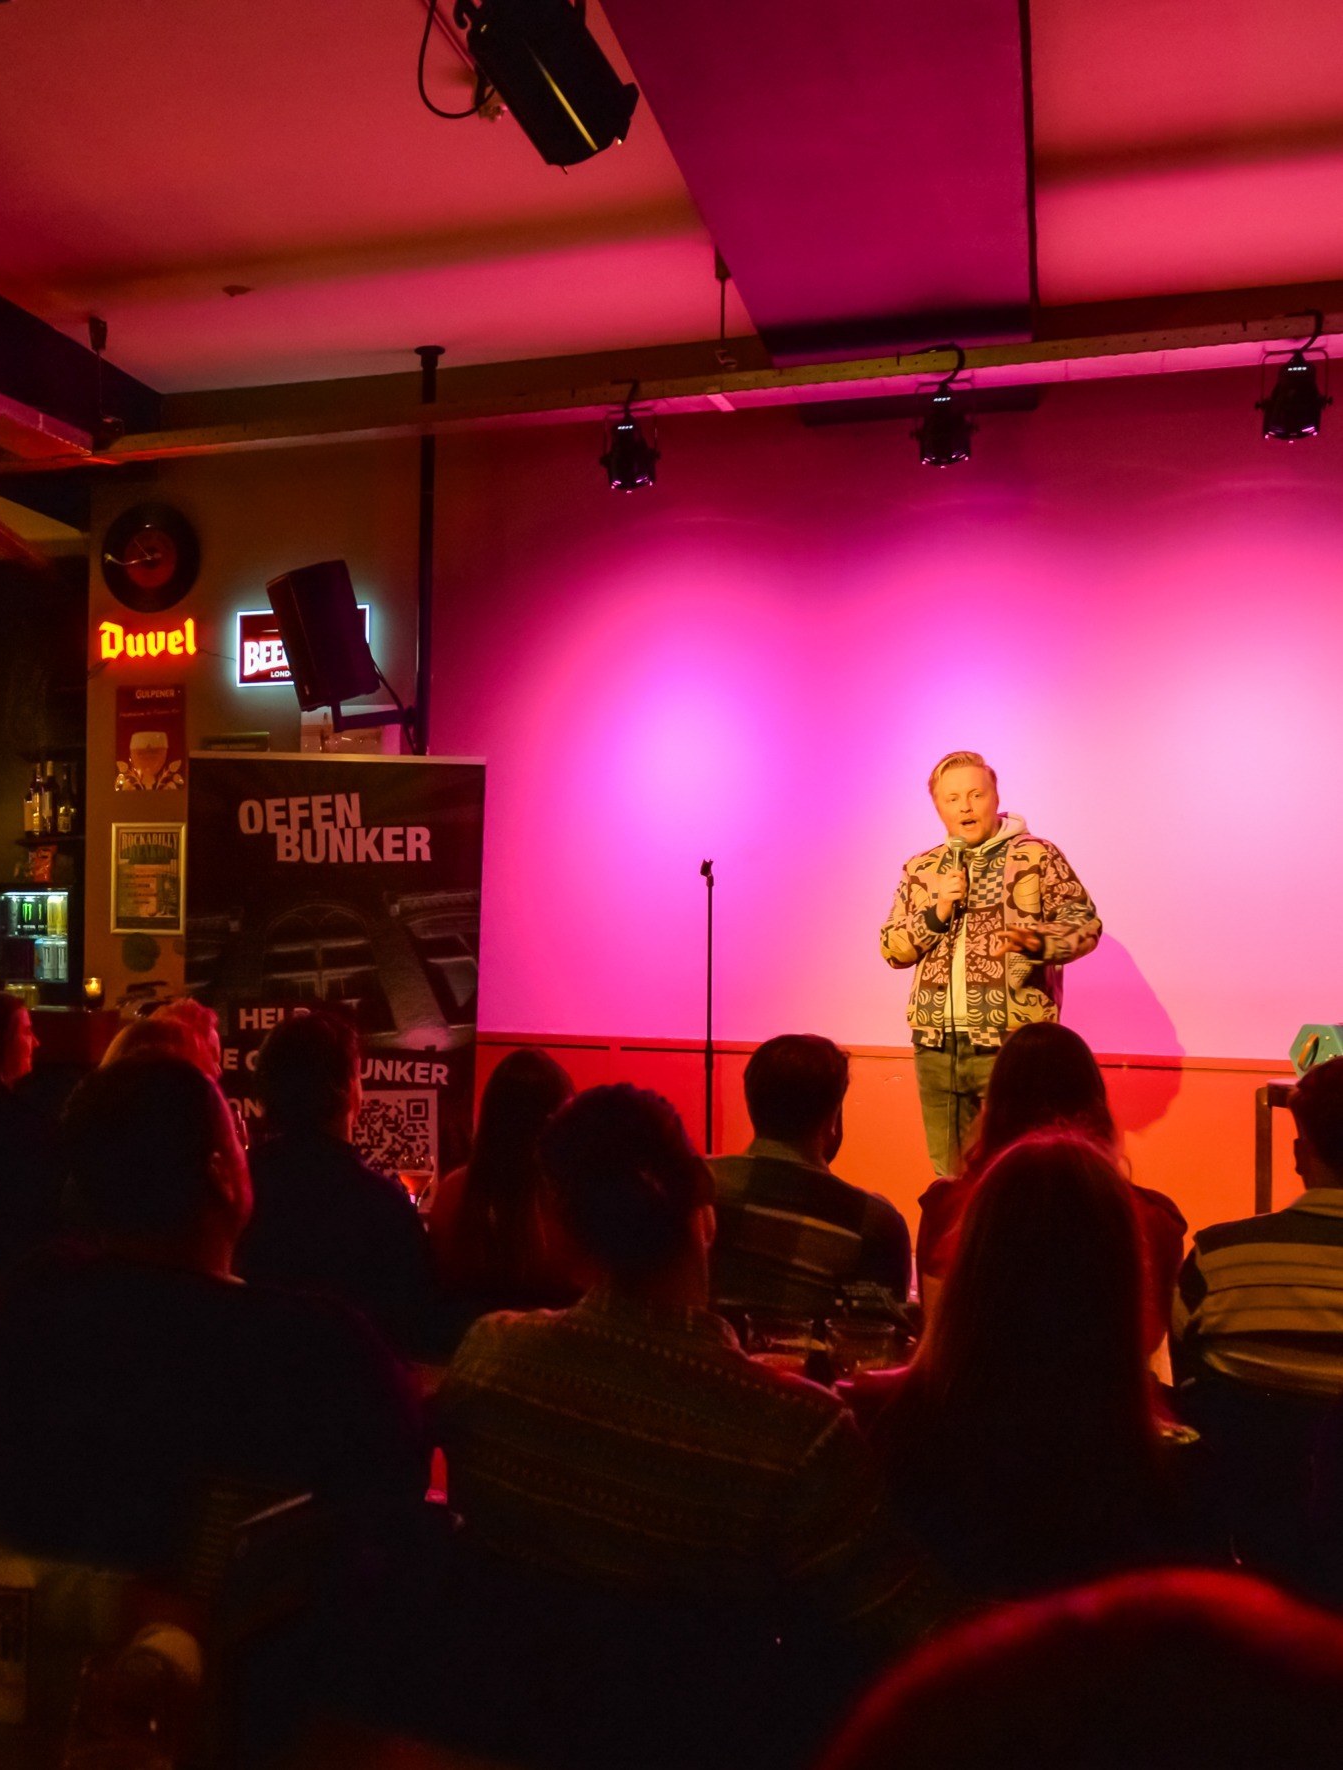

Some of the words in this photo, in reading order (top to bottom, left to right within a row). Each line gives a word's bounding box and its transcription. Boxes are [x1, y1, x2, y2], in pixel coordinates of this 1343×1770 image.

[98, 616, 197, 660] Duvel
[243, 639, 290, 676] BEE
[269, 670, 292, 678] LOND
[135, 688, 175, 699] GULPENER
[237, 791, 363, 835] OEFEN
[121, 832, 178, 849] ROCKABILLY
[275, 826, 432, 863] BUNKER
[359, 1057, 450, 1086] UNKER
